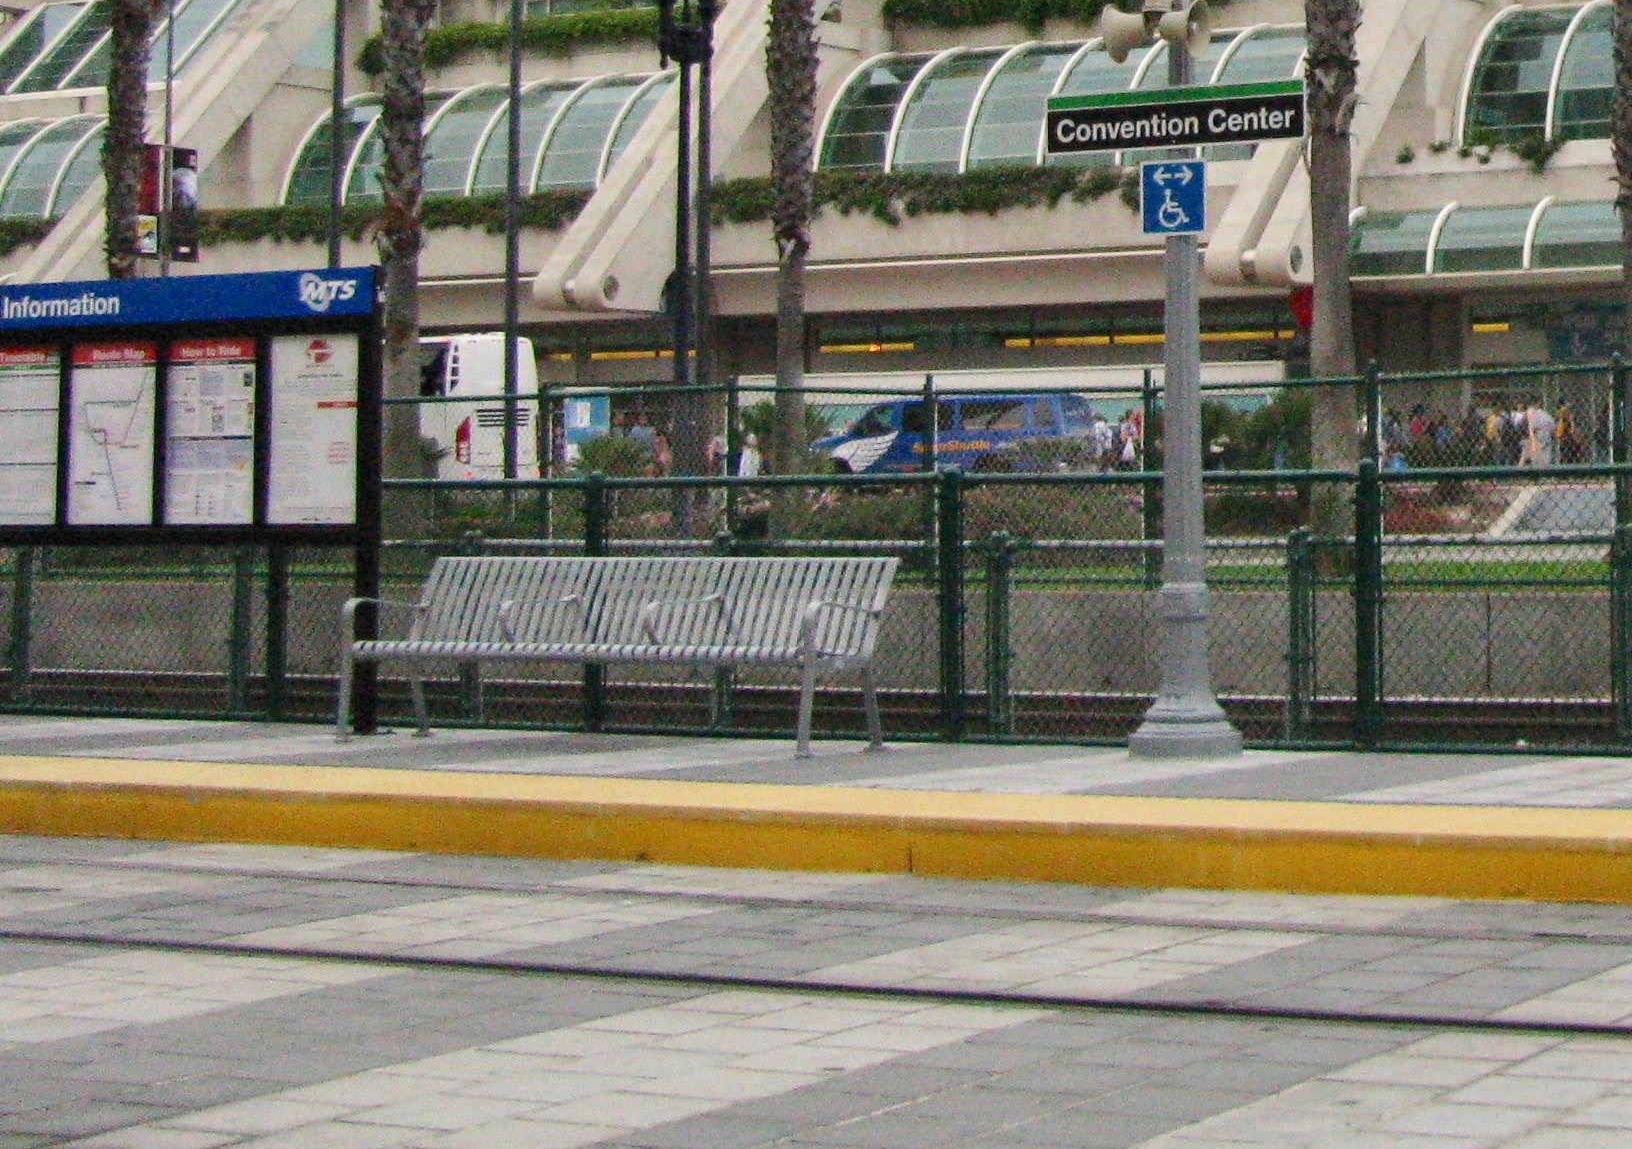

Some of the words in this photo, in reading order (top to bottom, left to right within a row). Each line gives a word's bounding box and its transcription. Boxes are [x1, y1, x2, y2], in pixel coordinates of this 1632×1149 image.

[1056, 112, 1200, 144] Convention
[1207, 106, 1295, 133] Center
[299, 276, 357, 304] MTS
[3, 292, 119, 319] Information
